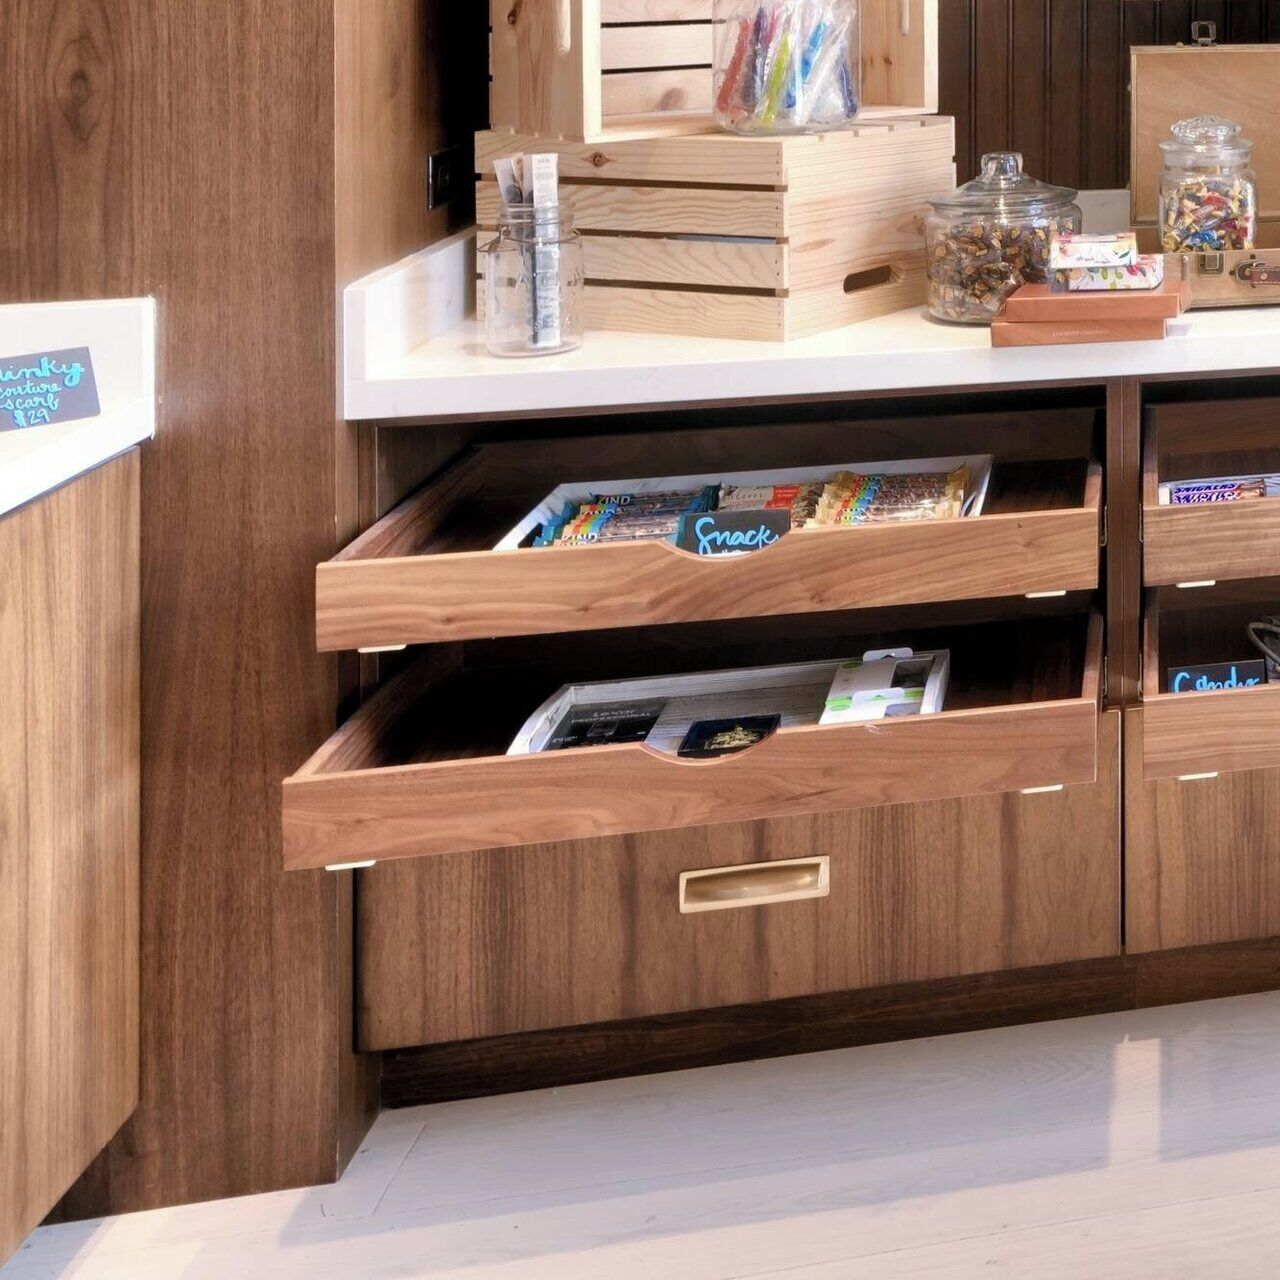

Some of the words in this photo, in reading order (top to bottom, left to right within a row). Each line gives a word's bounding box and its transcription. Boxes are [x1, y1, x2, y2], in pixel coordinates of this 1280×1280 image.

[0, 356, 85, 387] inky
[0, 393, 60, 411] scarf
[13, 408, 50, 428] $29
[598, 495, 631, 505] KIND
